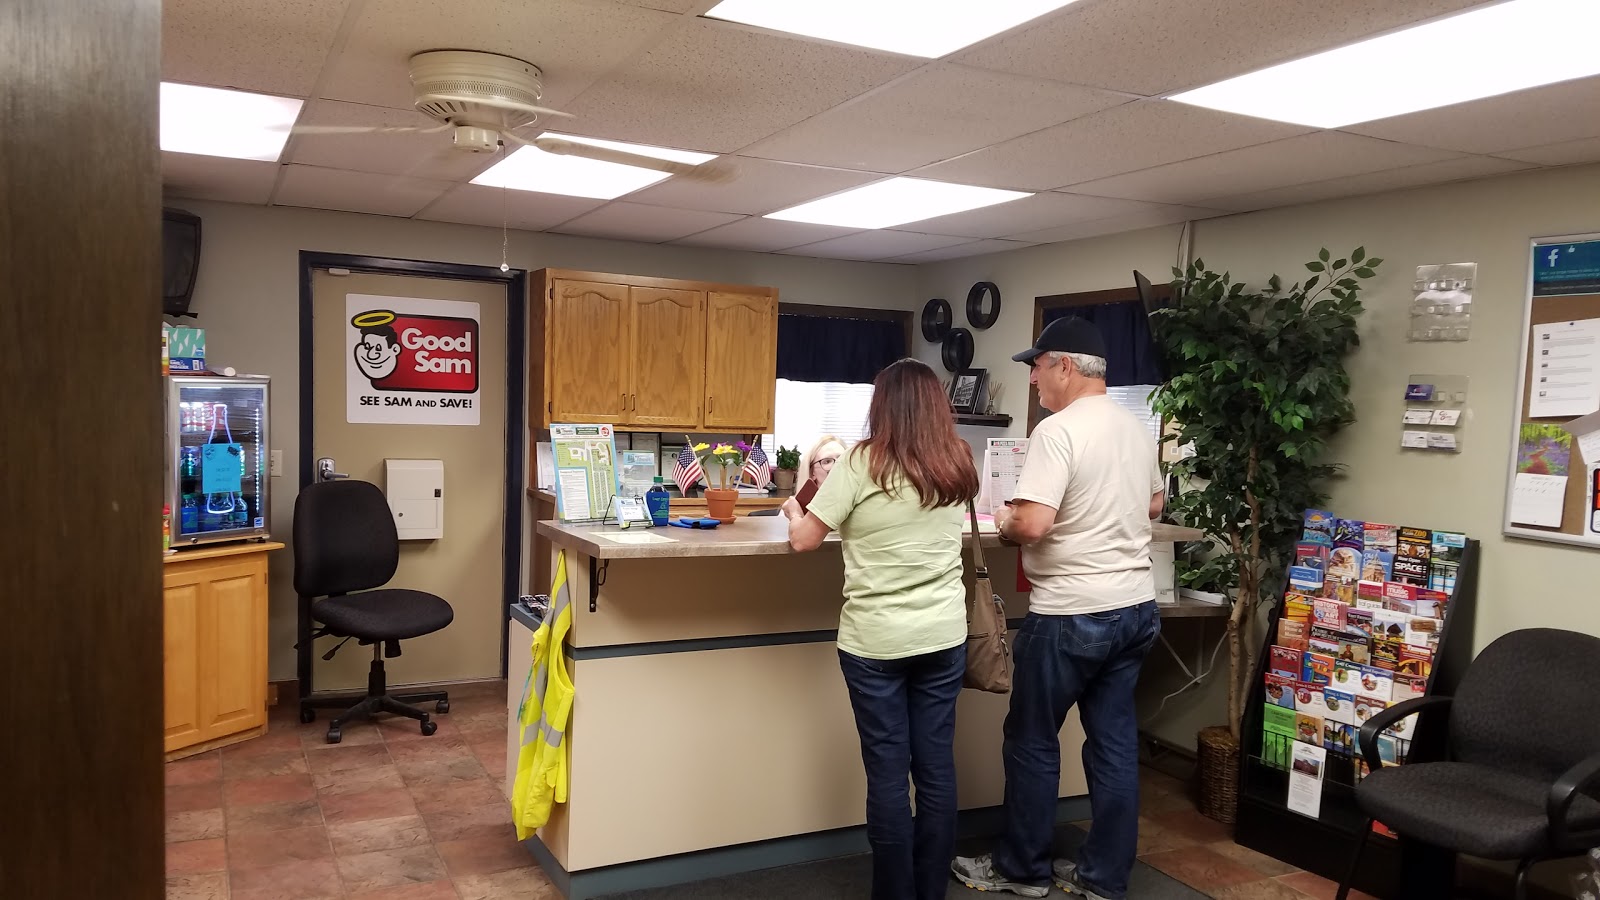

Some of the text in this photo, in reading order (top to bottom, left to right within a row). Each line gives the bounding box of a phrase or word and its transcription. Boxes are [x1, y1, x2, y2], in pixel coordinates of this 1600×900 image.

[401, 328, 471, 353] Good
[414, 350, 472, 374] Sam
[359, 395, 473, 409] SEE SAM AND SAVE!
[1394, 561, 1423, 573] SPACE
